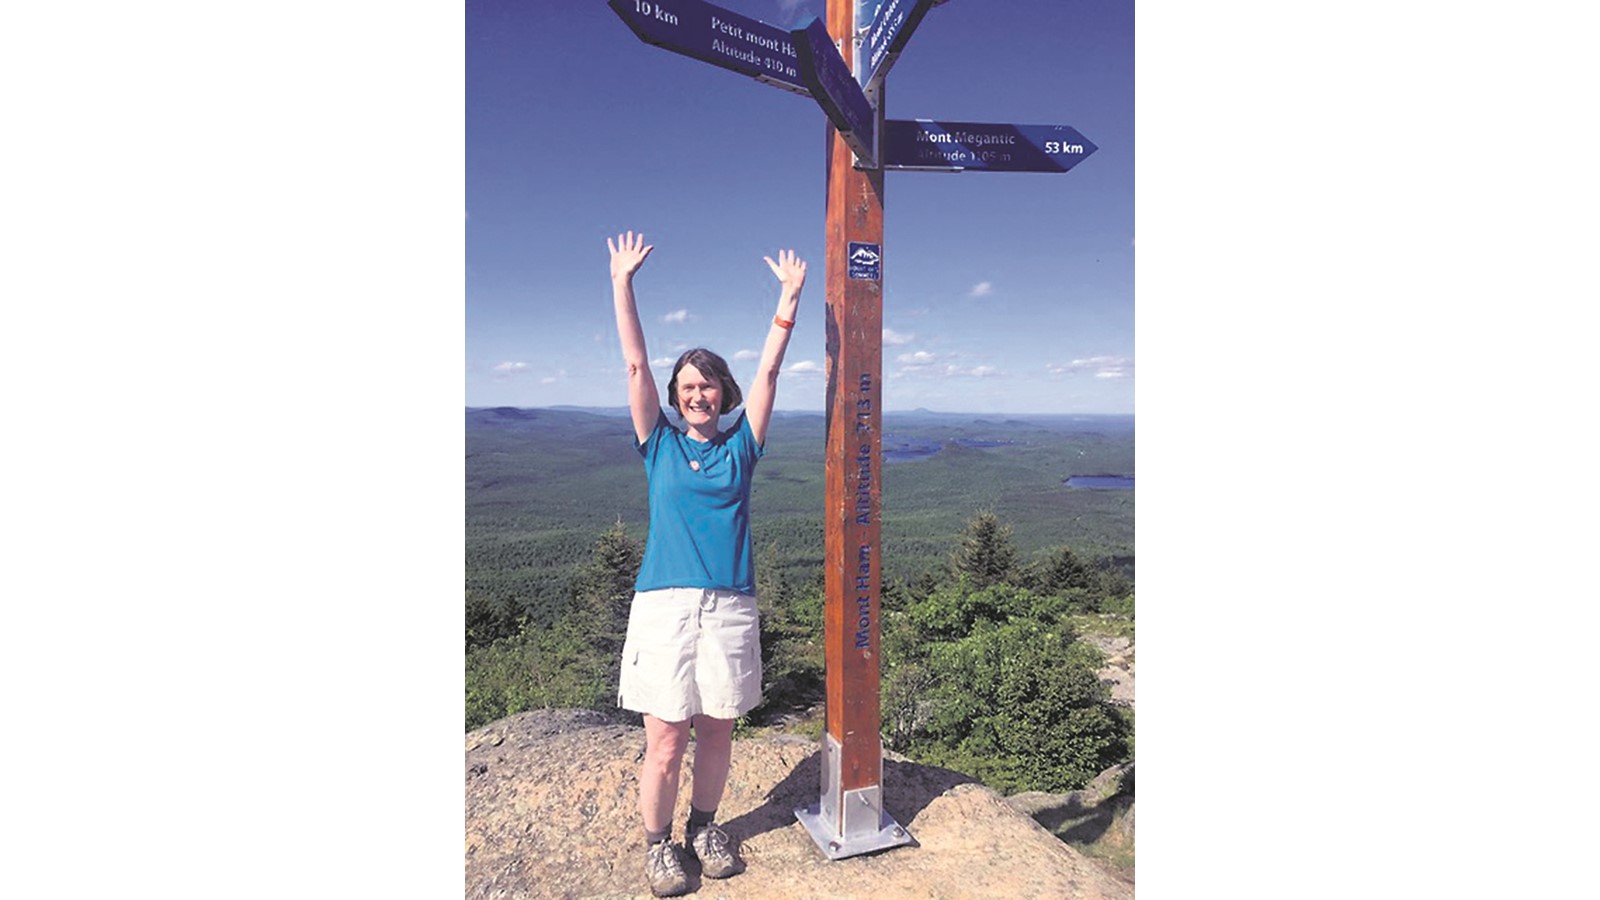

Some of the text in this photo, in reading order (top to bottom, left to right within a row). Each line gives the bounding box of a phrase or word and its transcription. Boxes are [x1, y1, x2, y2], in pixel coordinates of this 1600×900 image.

[634, 0, 678, 26] 10 km
[711, 16, 742, 40] Petit
[746, 32, 779, 53] mont
[712, 38, 797, 77] Altitude 410 m
[916, 130, 951, 143] Mont
[1045, 141, 1084, 154] 53 km
[860, 373, 871, 393] m
[856, 398, 871, 434] 713
[855, 444, 871, 526] Altitude
[855, 544, 871, 591] Ham
[855, 596, 870, 649] Mont
